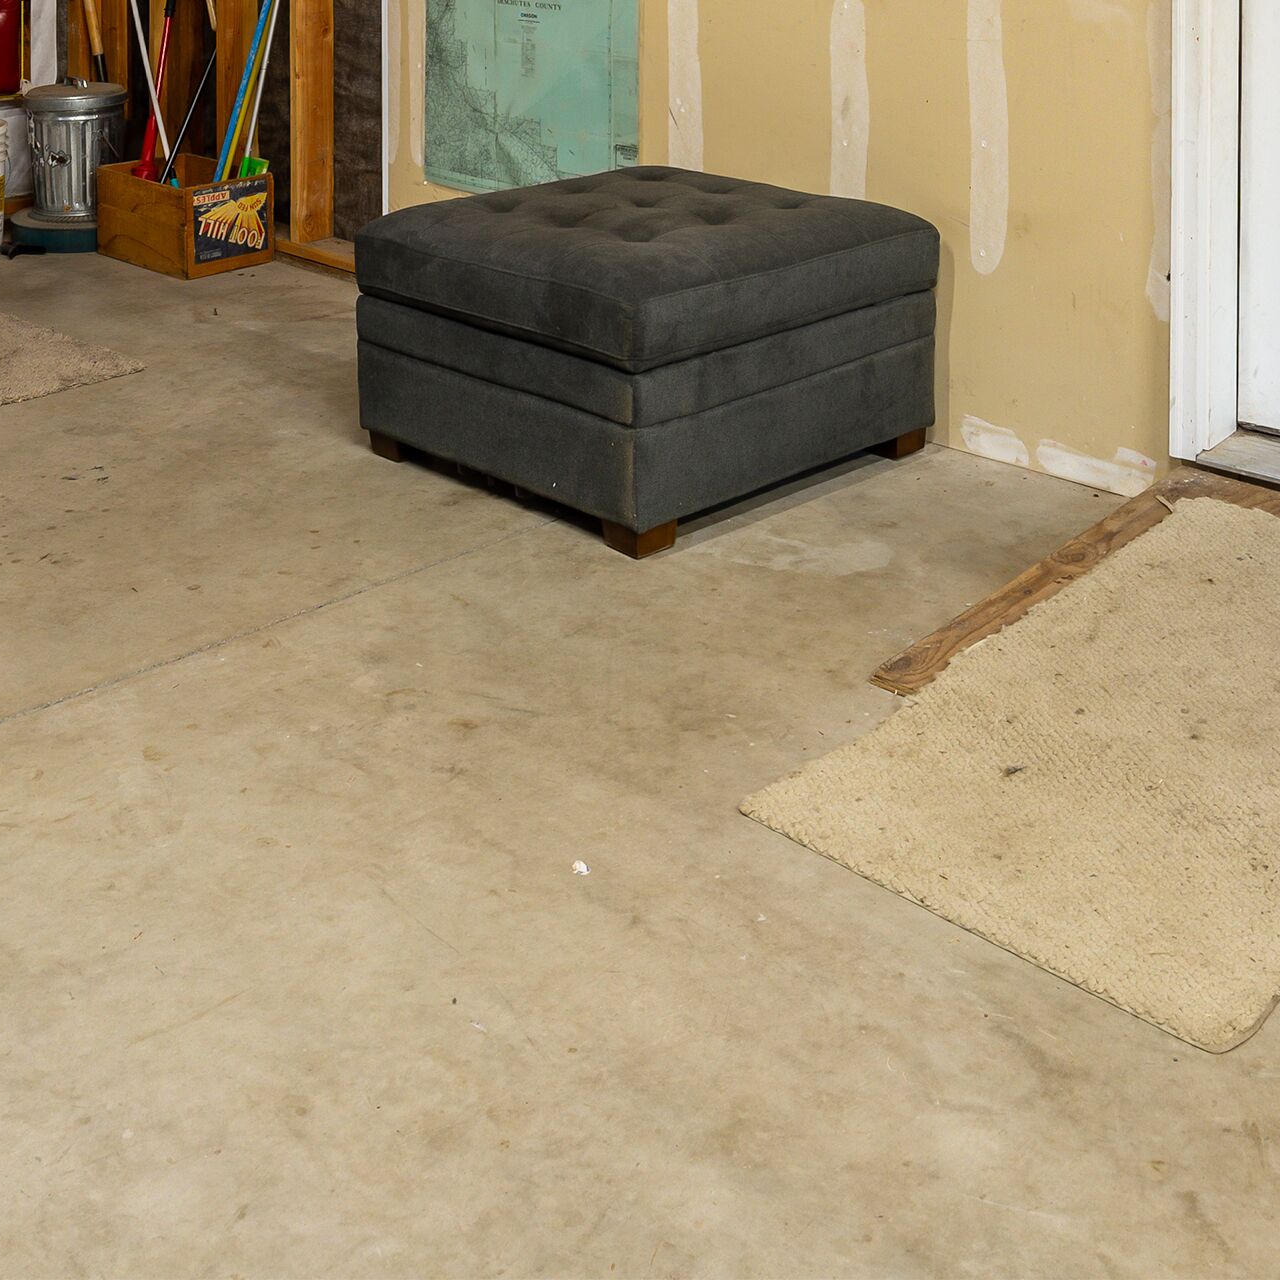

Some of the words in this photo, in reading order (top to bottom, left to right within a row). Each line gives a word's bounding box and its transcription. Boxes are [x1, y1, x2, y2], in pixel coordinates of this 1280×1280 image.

[535, 2, 561, 10] COUNTY
[195, 191, 227, 203] APPLES
[237, 201, 249, 212] FED
[249, 197, 262, 211] SUN
[197, 216, 229, 241] HILL
[227, 224, 265, 250] FOOT
